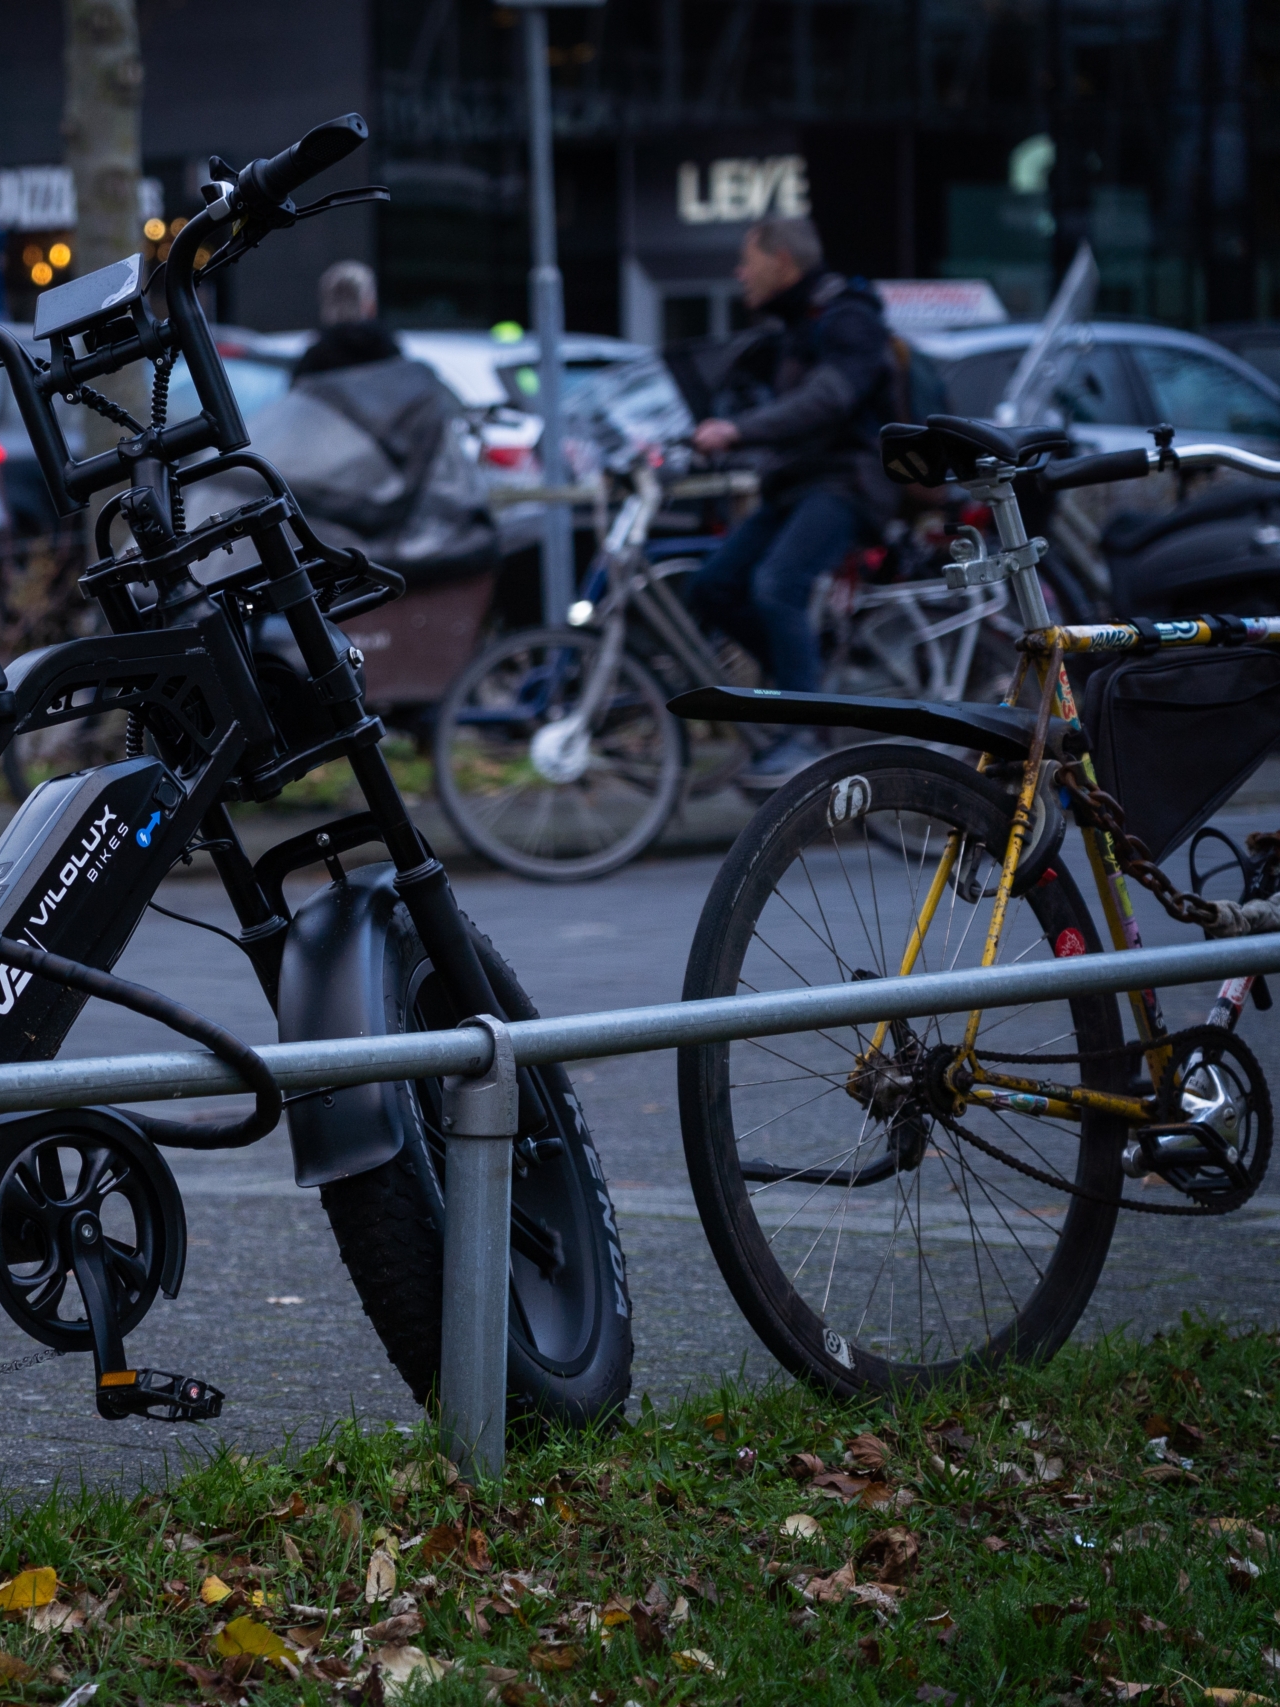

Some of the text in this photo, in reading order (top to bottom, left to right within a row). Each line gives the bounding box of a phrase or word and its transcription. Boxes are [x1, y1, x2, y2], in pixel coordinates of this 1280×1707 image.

[29, 804, 117, 926] VILOLUX
[86, 822, 129, 883] BIKES
[563, 1093, 629, 1319] KENDA
